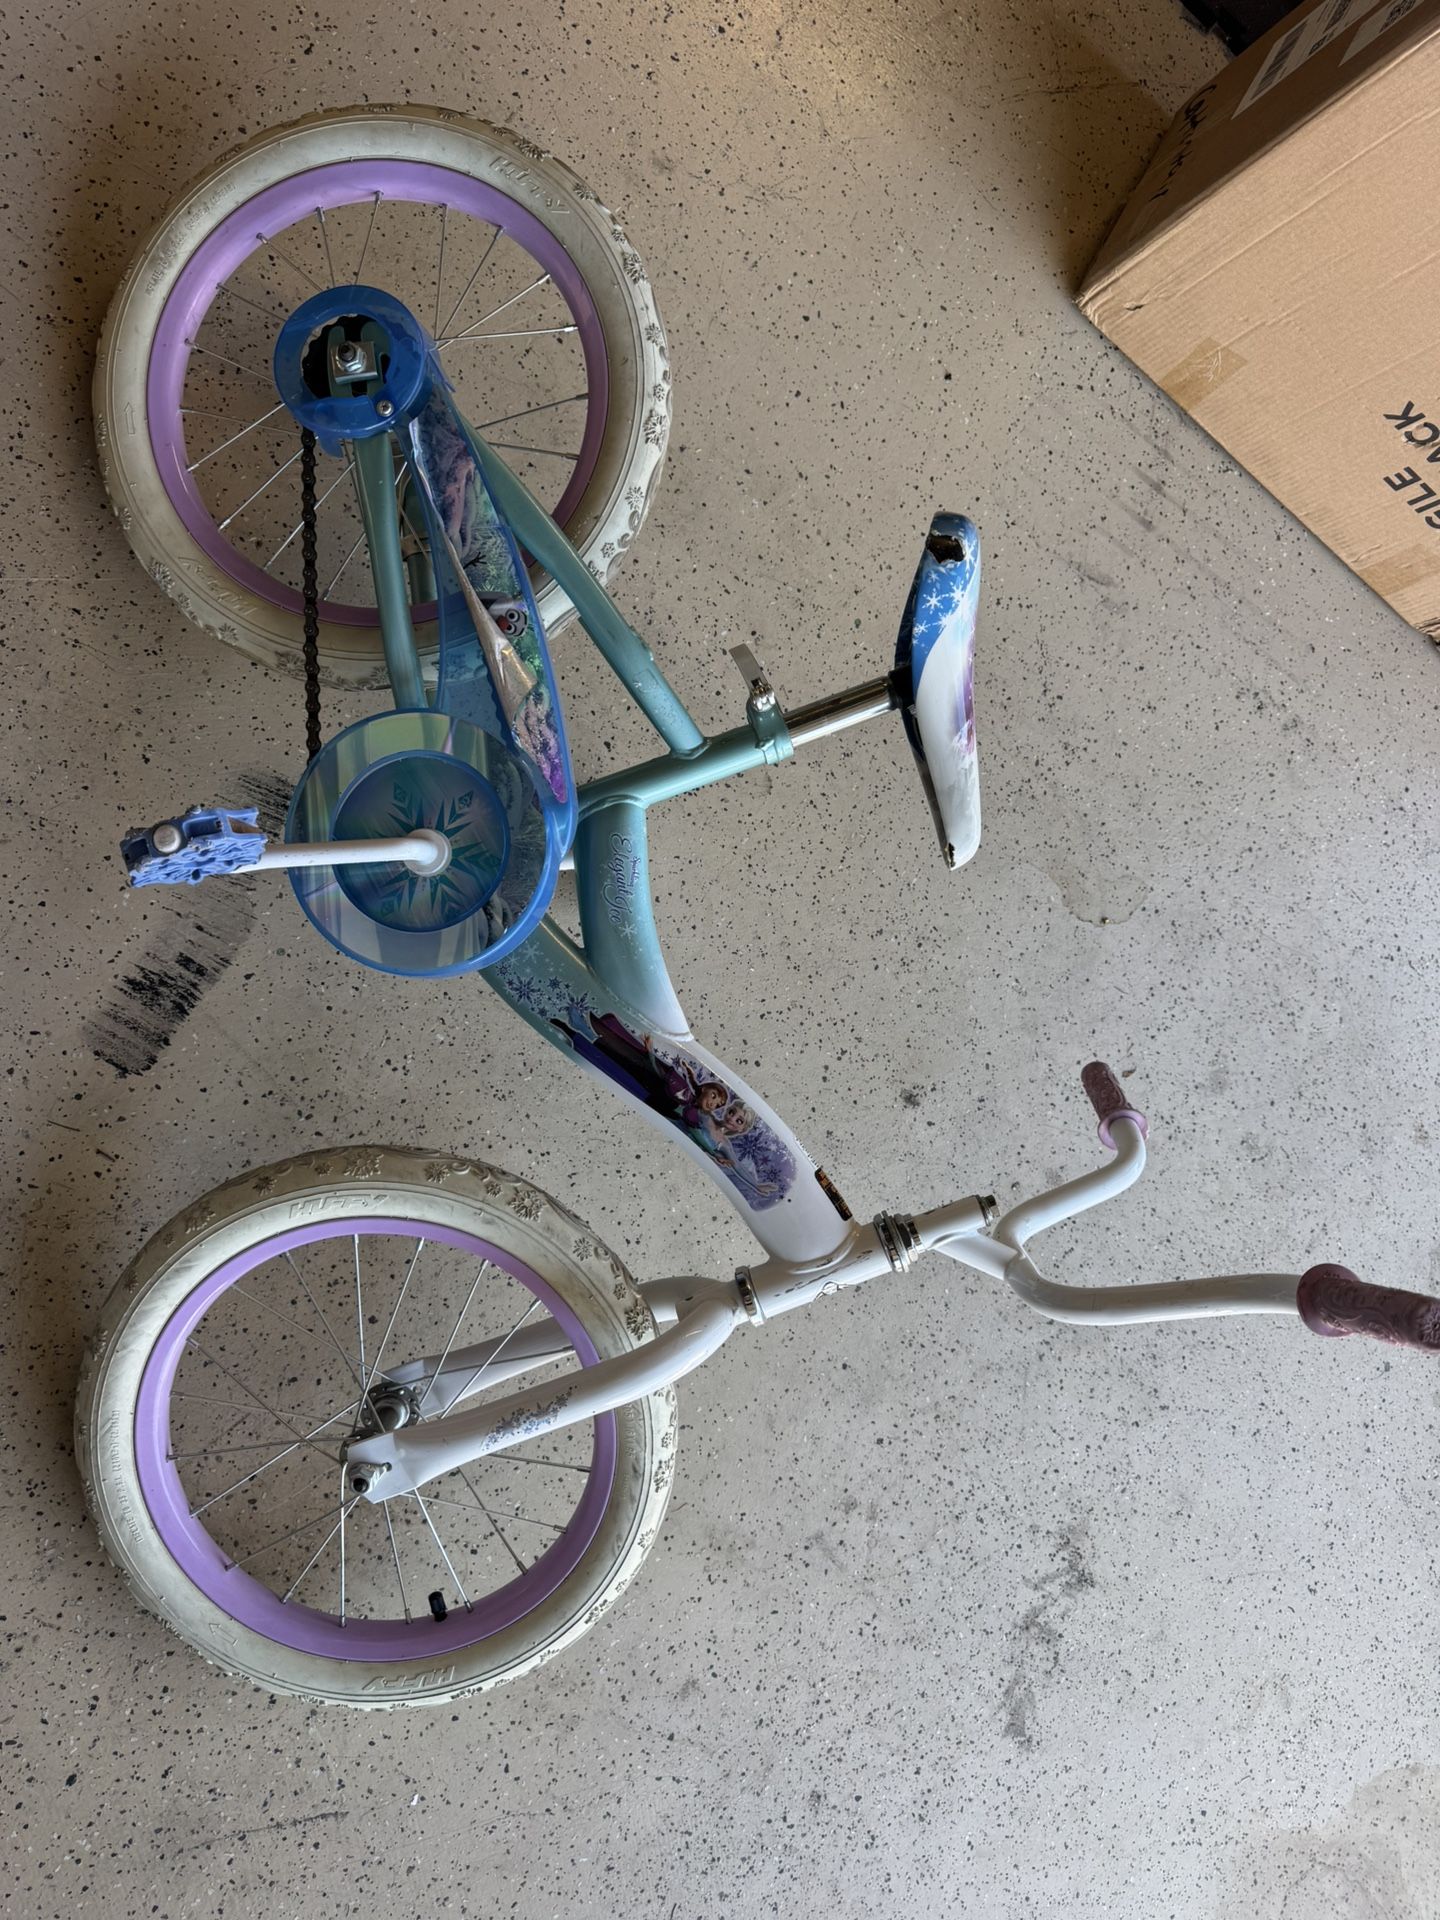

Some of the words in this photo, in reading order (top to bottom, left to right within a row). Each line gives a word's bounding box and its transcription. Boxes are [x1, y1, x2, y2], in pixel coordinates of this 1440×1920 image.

[607, 834, 632, 896] Elegant
[603, 884, 632, 924] Ice
[289, 1194, 389, 1219] HUFFY
[362, 1666, 455, 1693] HUFFY
